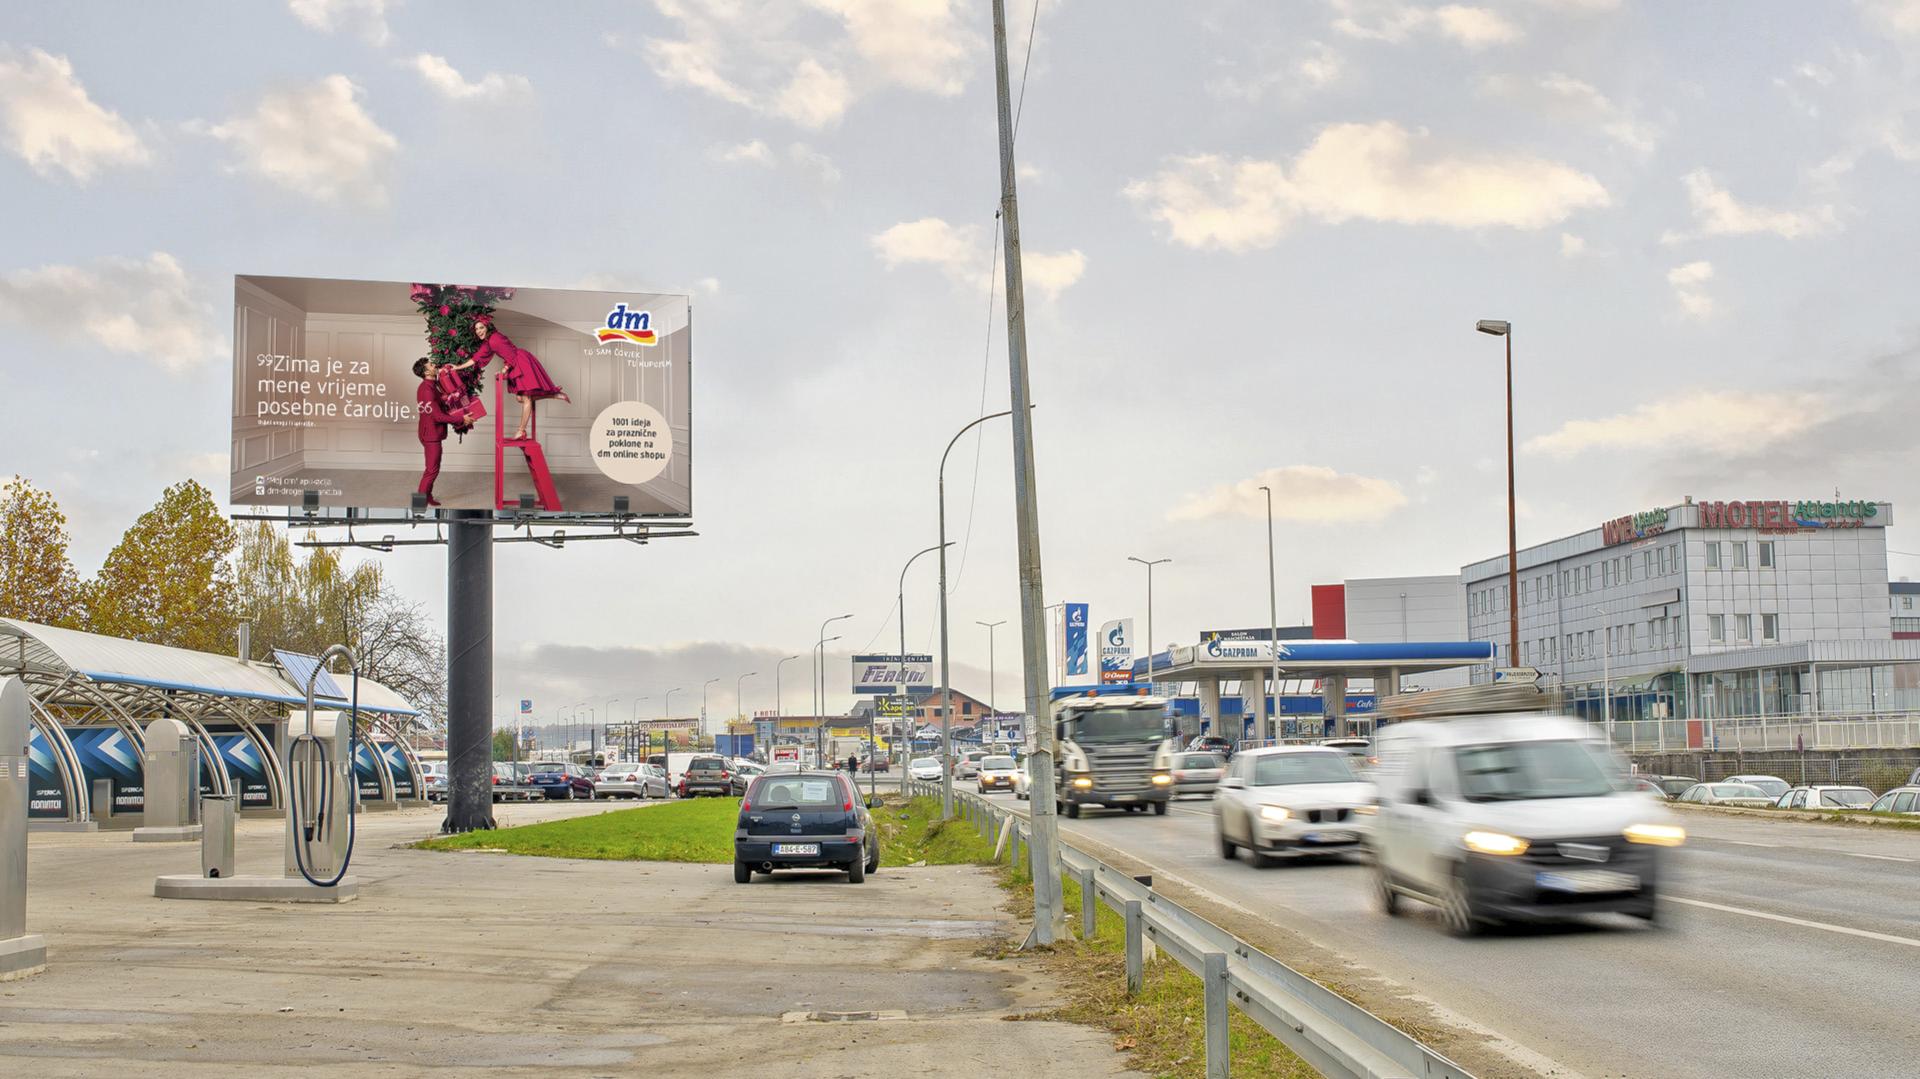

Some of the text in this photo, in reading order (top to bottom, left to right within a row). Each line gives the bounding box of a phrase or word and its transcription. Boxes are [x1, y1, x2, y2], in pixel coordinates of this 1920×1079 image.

[607, 304, 650, 329] dm
[326, 357, 343, 377] je
[349, 361, 370, 374] za
[258, 379, 386, 399] mene vrijeme
[257, 399, 337, 418] posebne
[612, 417, 651, 428] 1001 ideja
[617, 429, 657, 438] praznične
[609, 440, 641, 448] poklone
[597, 450, 665, 460] dm online shopu
[1699, 500, 1877, 528] MOTEL Atlantis
[1602, 515, 1636, 546] MOTEL
[1103, 647, 1130, 655] GAZPROM
[1223, 648, 1258, 657] GAZPROM
